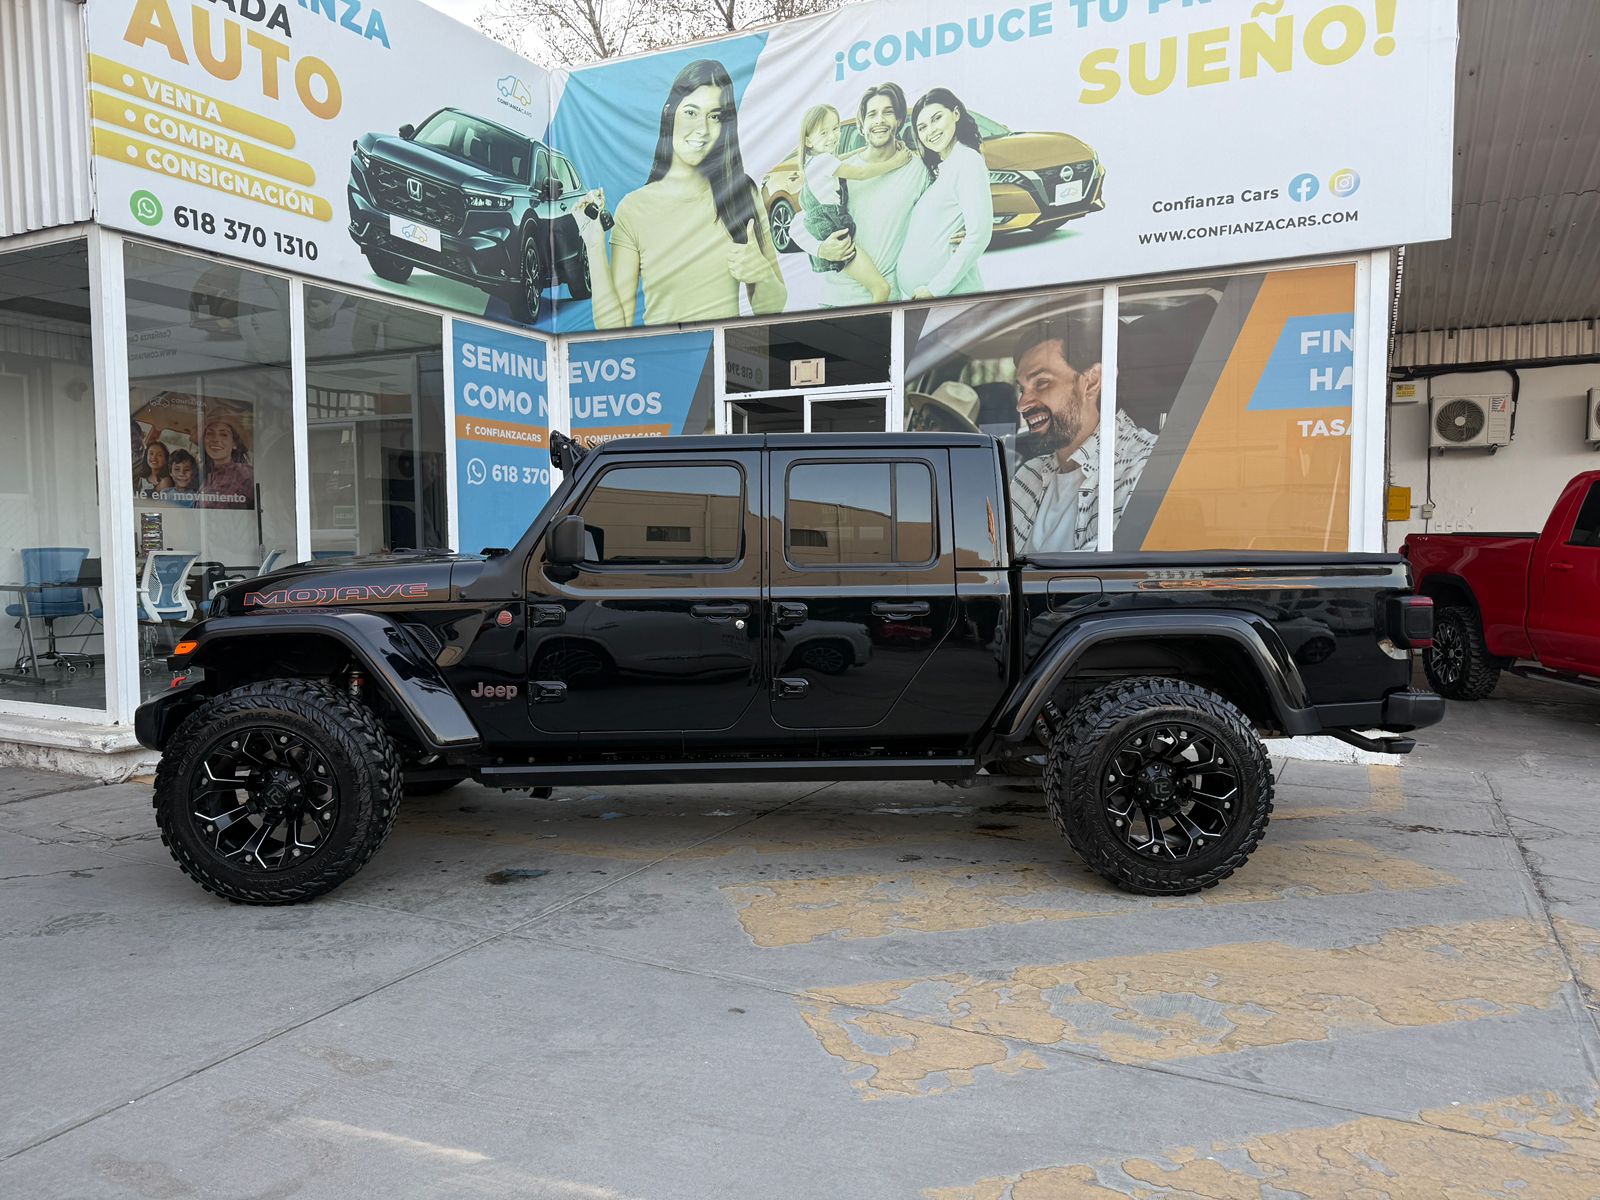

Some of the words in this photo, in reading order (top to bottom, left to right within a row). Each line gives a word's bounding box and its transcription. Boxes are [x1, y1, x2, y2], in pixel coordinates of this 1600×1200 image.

[298, 0, 391, 49] NZA
[835, 2, 1053, 81] ¡CONDUCE
[123, 0, 343, 120] AUTO
[1079, 0, 1396, 104] SUEÑO!
[142, 76, 222, 123] VENTA
[144, 112, 245, 162] COMPRA
[145, 148, 314, 215] CONSIGNACIÓN
[1152, 194, 1235, 213] Confianza
[1241, 188, 1280, 203] Cars
[174, 205, 216, 235] 618
[223, 217, 267, 248] 370
[273, 231, 318, 261] 1310
[1138, 210, 1359, 245] WWW.CONFIANZACARS.COM
[1301, 328, 1353, 354] FIN
[462, 342, 547, 382] SEMINU
[464, 382, 533, 415] COMO
[570, 392, 663, 419] UEVOS
[474, 425, 542, 443] CONFIANZACARS
[492, 464, 519, 483] 618
[522, 466, 549, 485] 370
[151, 491, 168, 500] en
[173, 491, 247, 503] movimiento
[243, 582, 428, 607] MOJAVE
[470, 681, 518, 700] Jeep
